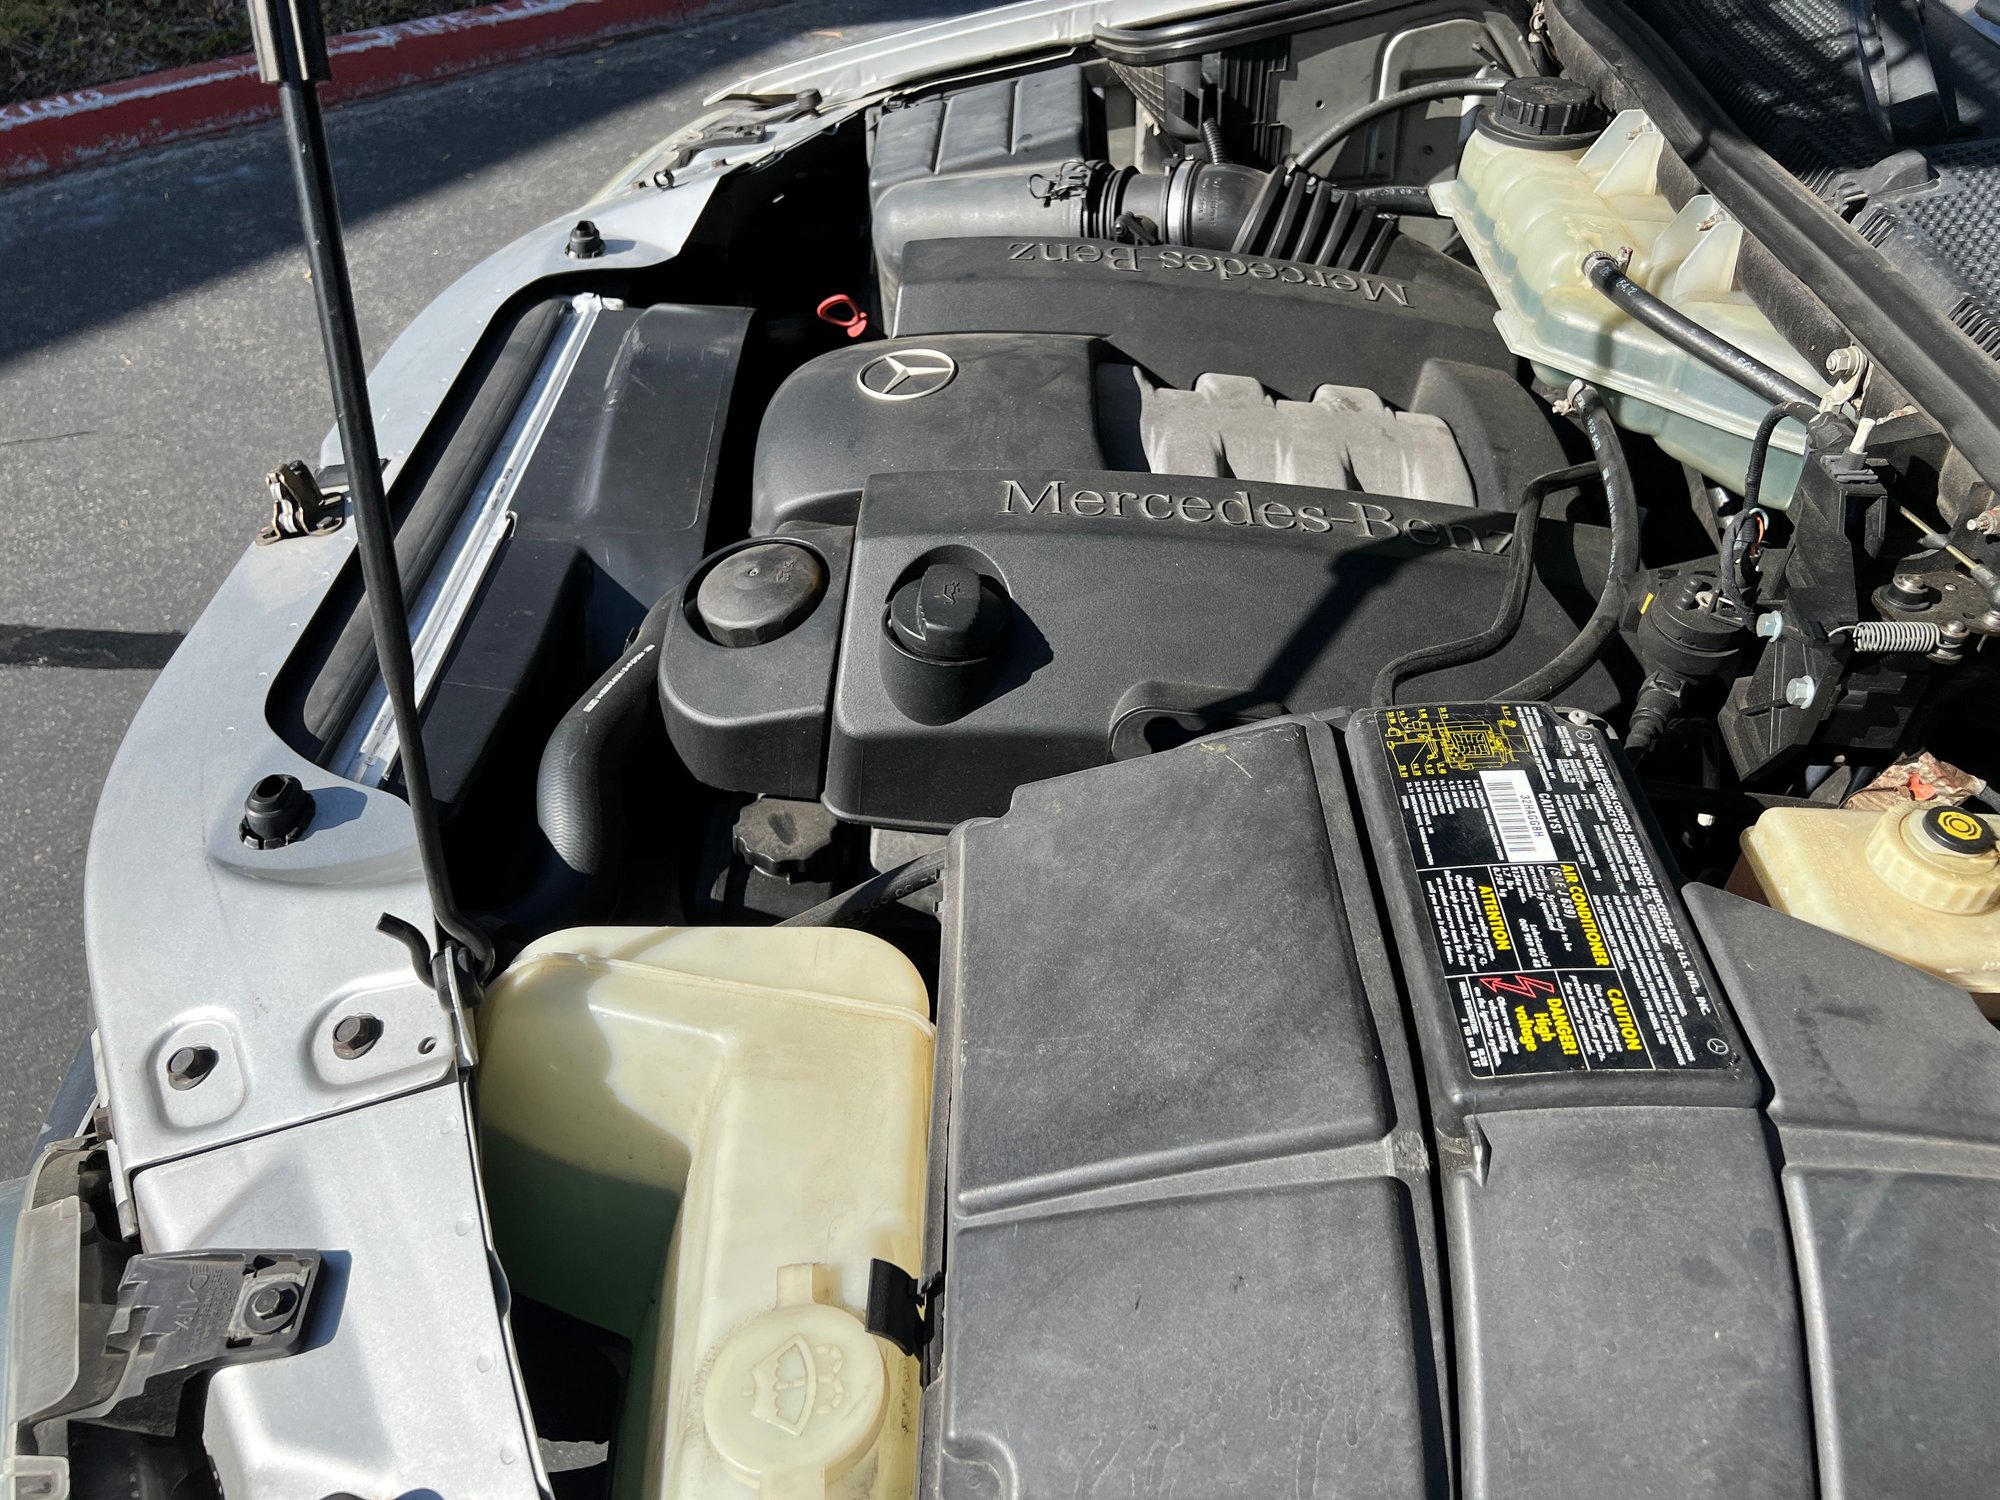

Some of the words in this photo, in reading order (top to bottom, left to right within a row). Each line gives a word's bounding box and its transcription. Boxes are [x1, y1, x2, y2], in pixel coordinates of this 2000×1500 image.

[1007, 241, 1416, 308] Mercedes-Benz
[1577, 742, 1592, 759] MFD.
[1584, 758, 1602, 781] UNDER
[1536, 792, 1565, 834] CATALYST
[1594, 782, 1618, 817] CONTRACT
[1609, 818, 1624, 832] FOR
[1559, 863, 1580, 883] AIR
[1586, 742, 1605, 767] VEHICLE
[1596, 767, 1619, 800] EMISSION
[1611, 800, 1634, 833] CONTROL
[1625, 833, 1656, 886] INFORMATION
[1647, 886, 1684, 950] MERCEDES-BENZ
[1674, 951, 1692, 968] U.S.
[1693, 995, 1712, 1015] INC.
[1615, 833, 1647, 886] DAIMLER-BENZ
[1637, 887, 1653, 902] AG,
[1477, 884, 1512, 950] ATTENTION
[1567, 885, 1610, 966] CONDITIONER
[1644, 903, 1671, 945] GERMANY
[1508, 1004, 1543, 1052] voltage
[1528, 1012, 1558, 1042] High
[1544, 997, 1580, 1055] DANGER!
[1604, 987, 1643, 1051] CAUTION
